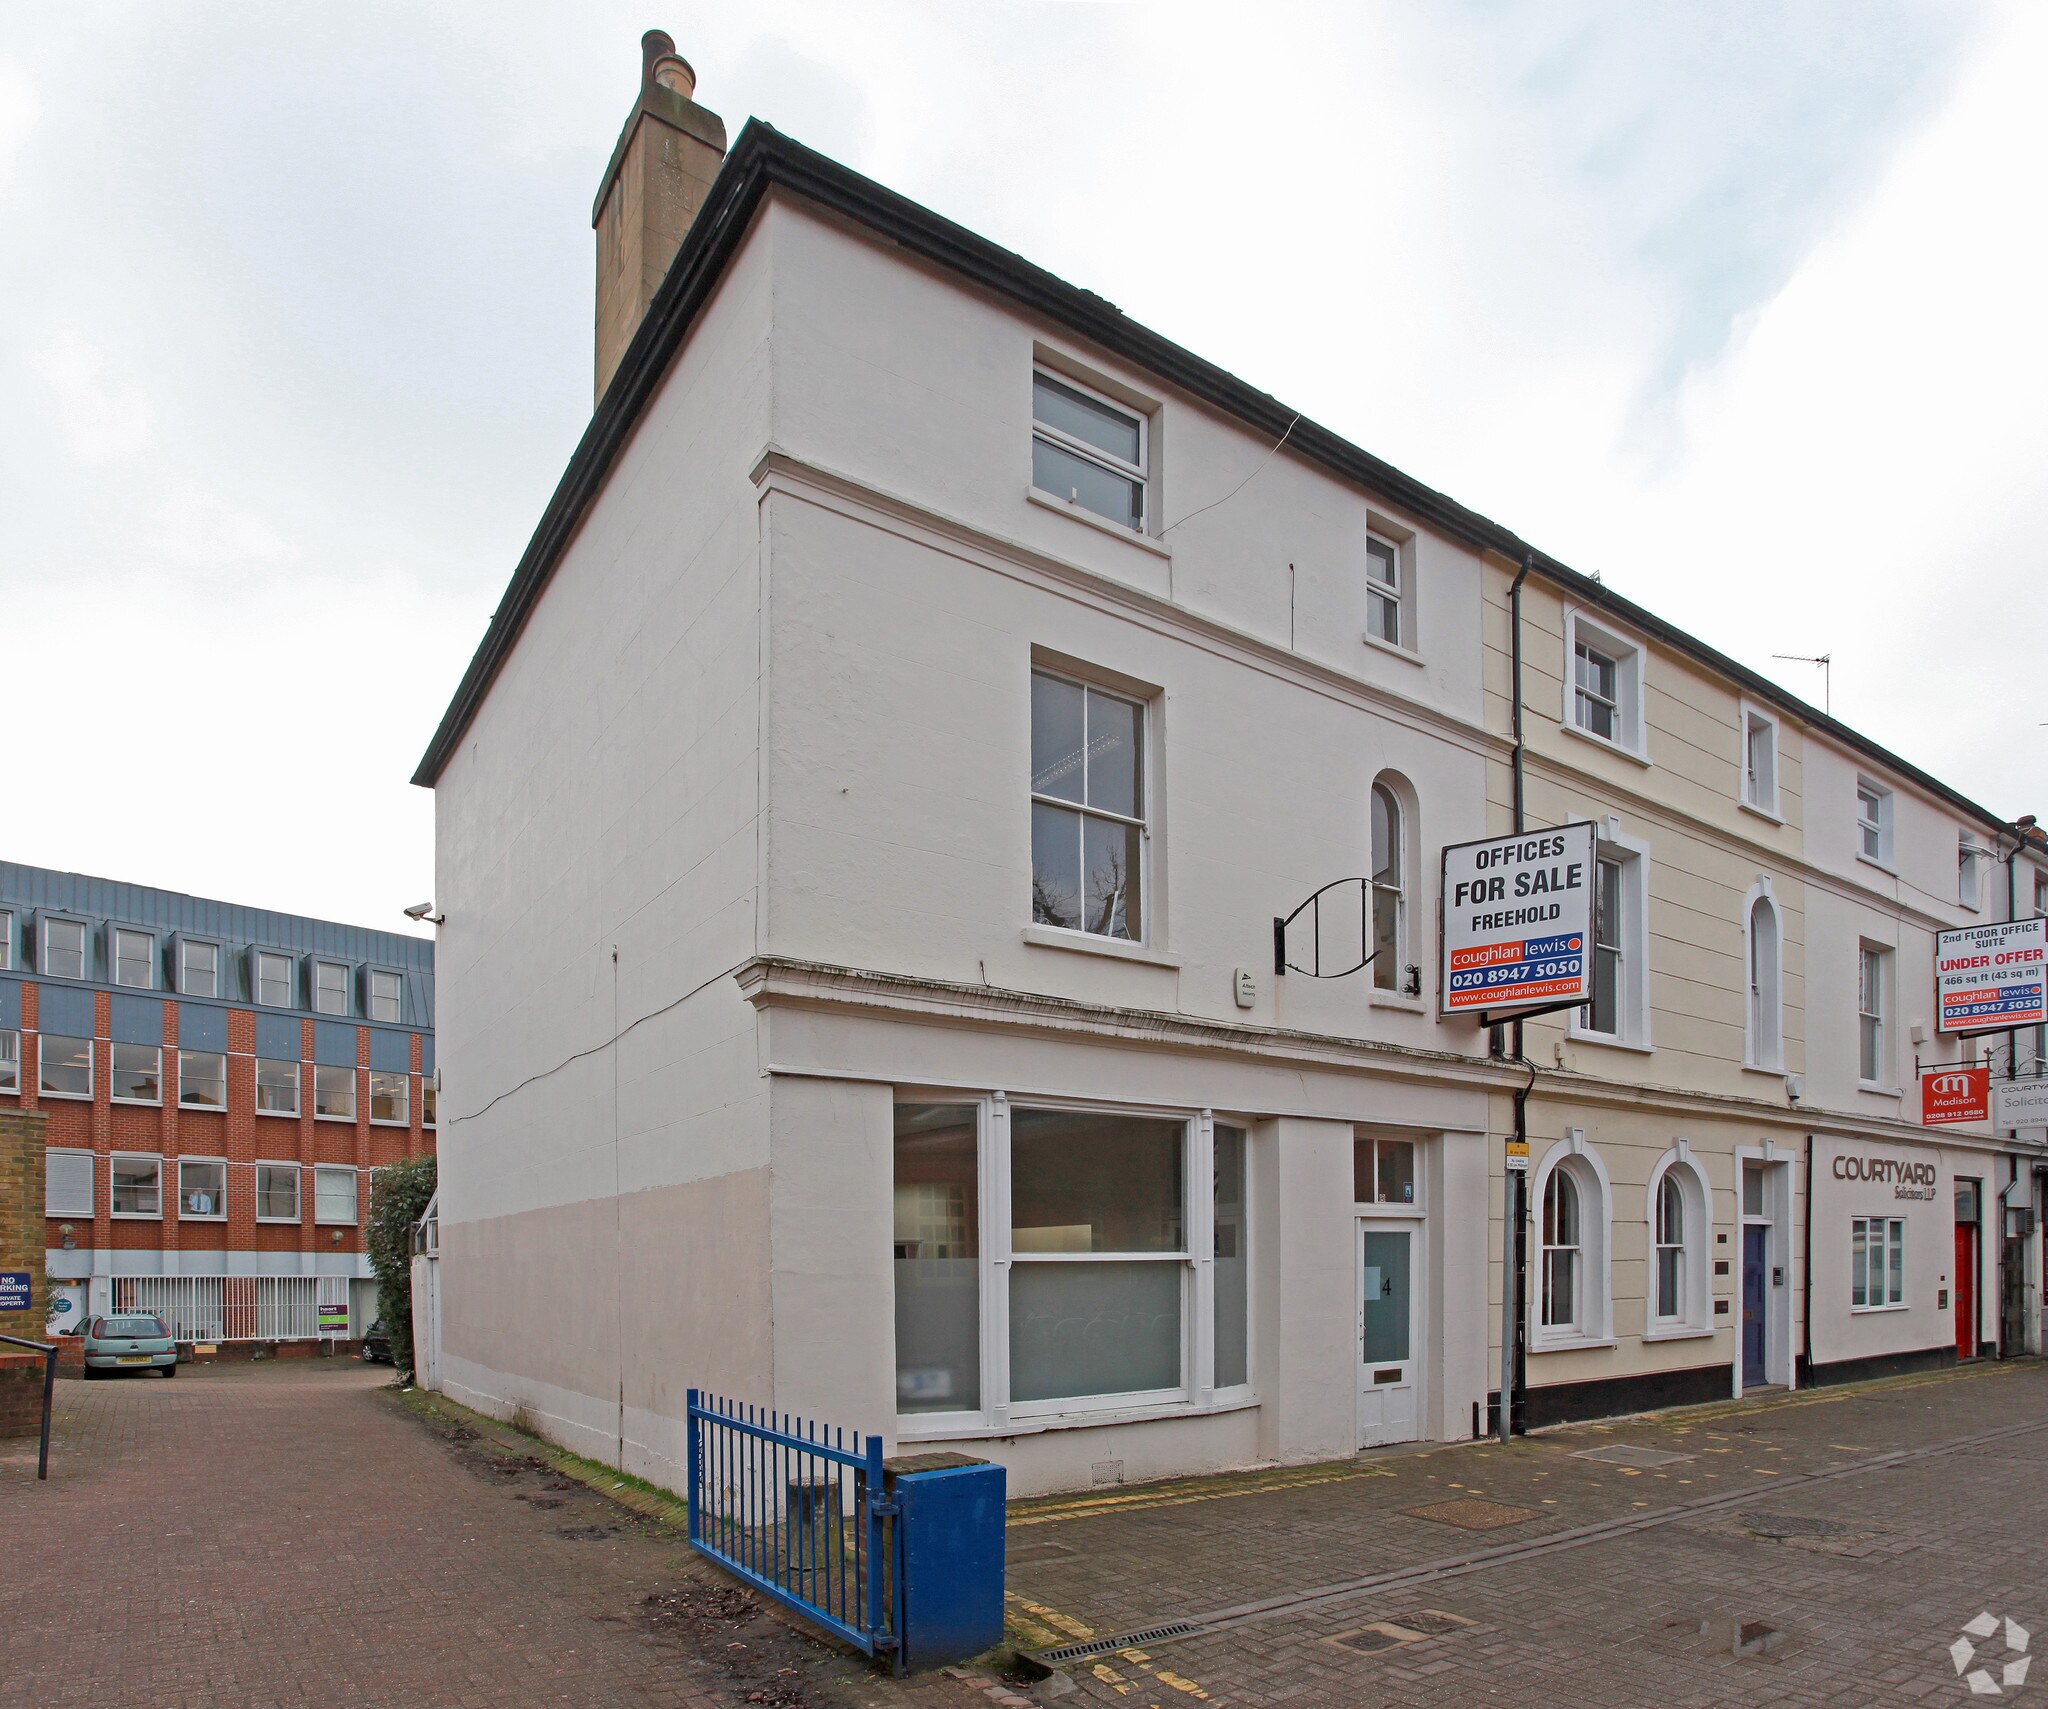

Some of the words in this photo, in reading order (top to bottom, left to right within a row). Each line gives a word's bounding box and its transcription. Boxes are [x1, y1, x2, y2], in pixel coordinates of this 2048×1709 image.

[1476, 835, 1565, 870] OFFICES
[1455, 877, 1505, 907] FOR
[1514, 863, 1582, 898] SALE
[1472, 903, 1560, 931] FREEHOLD
[1943, 934, 1961, 943] 2nd
[1965, 929, 1998, 940] FLOOR
[2001, 922, 2039, 936] OFFICE
[1452, 945, 1520, 966] coughlan
[1525, 939, 1567, 956] lewis
[1975, 937, 2006, 949] SUITE
[1940, 955, 1989, 972] UNDER
[1994, 949, 2044, 965] OFFER
[1452, 972, 1483, 988] 020
[1487, 965, 1530, 983] 8947
[1534, 960, 1580, 977] 5050
[1944, 976, 1963, 985] 466
[1965, 976, 1977, 984] sq
[1980, 973, 1989, 981] ft
[1991, 971, 2007, 981] (43
[2010, 969, 2022, 978] sq
[2025, 967, 2039, 977] m)
[1452, 980, 1580, 1004] www.coughlanlewis.com
[1945, 990, 1996, 1004] coughlan
[1999, 986, 2030, 997] lewis
[1945, 1006, 1969, 1017] 020
[1972, 1002, 2004, 1014] 8947
[2008, 999, 2041, 1010] 5050
[1945, 1011, 2041, 1026] www.coughlanlewis.com
[1933, 1096, 1976, 1107] Madison
[1926, 1112, 1946, 1120] 0208
[1947, 1110, 1962, 1118] 912
[1832, 1155, 1936, 1186] COURTYARD
[1894, 1185, 1923, 1200] Solicitors
[1923, 1187, 1937, 1201] LLP
[2, 1276, 15, 1284] NO
[1382, 1277, 1392, 1296] 4
